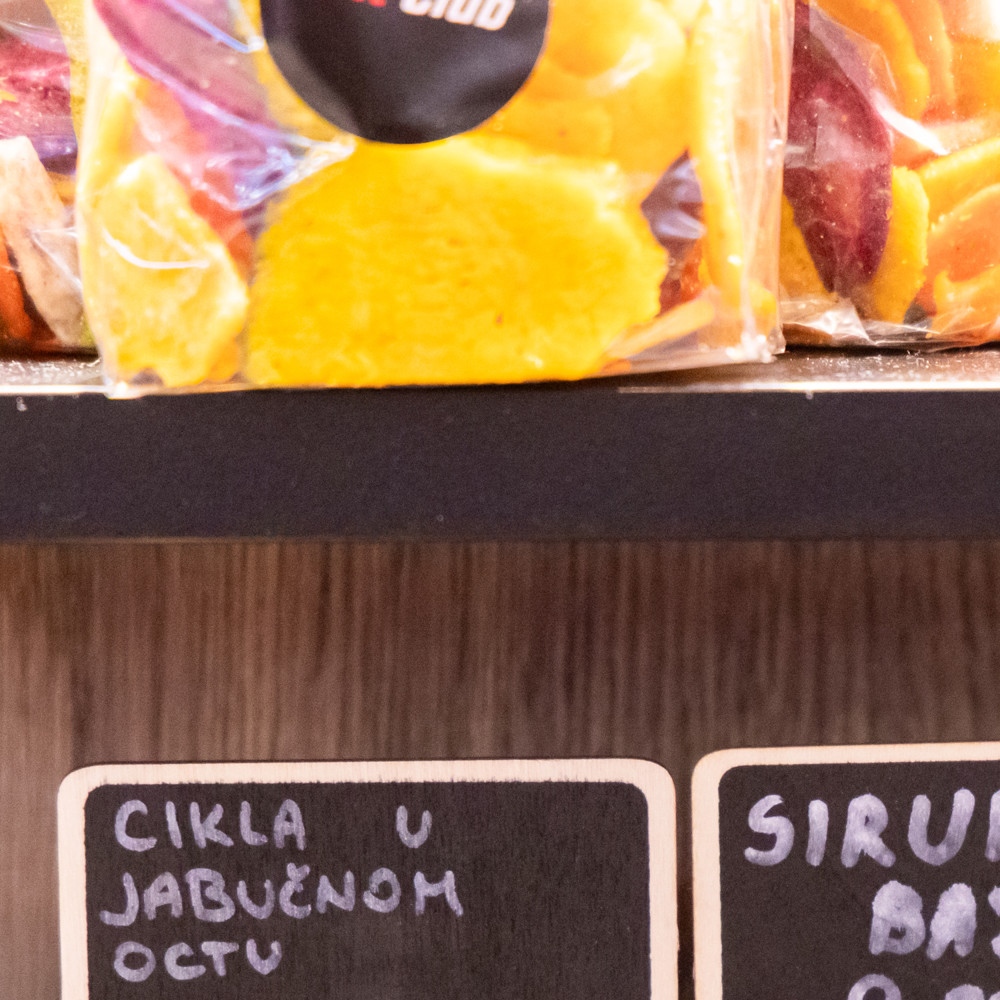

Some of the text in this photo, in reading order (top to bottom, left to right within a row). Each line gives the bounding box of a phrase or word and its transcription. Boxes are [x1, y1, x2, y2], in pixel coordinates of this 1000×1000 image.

[114, 800, 432, 852] CIKLA U
[101, 863, 464, 927] JABUČNOM
[113, 940, 282, 982] OCTU
